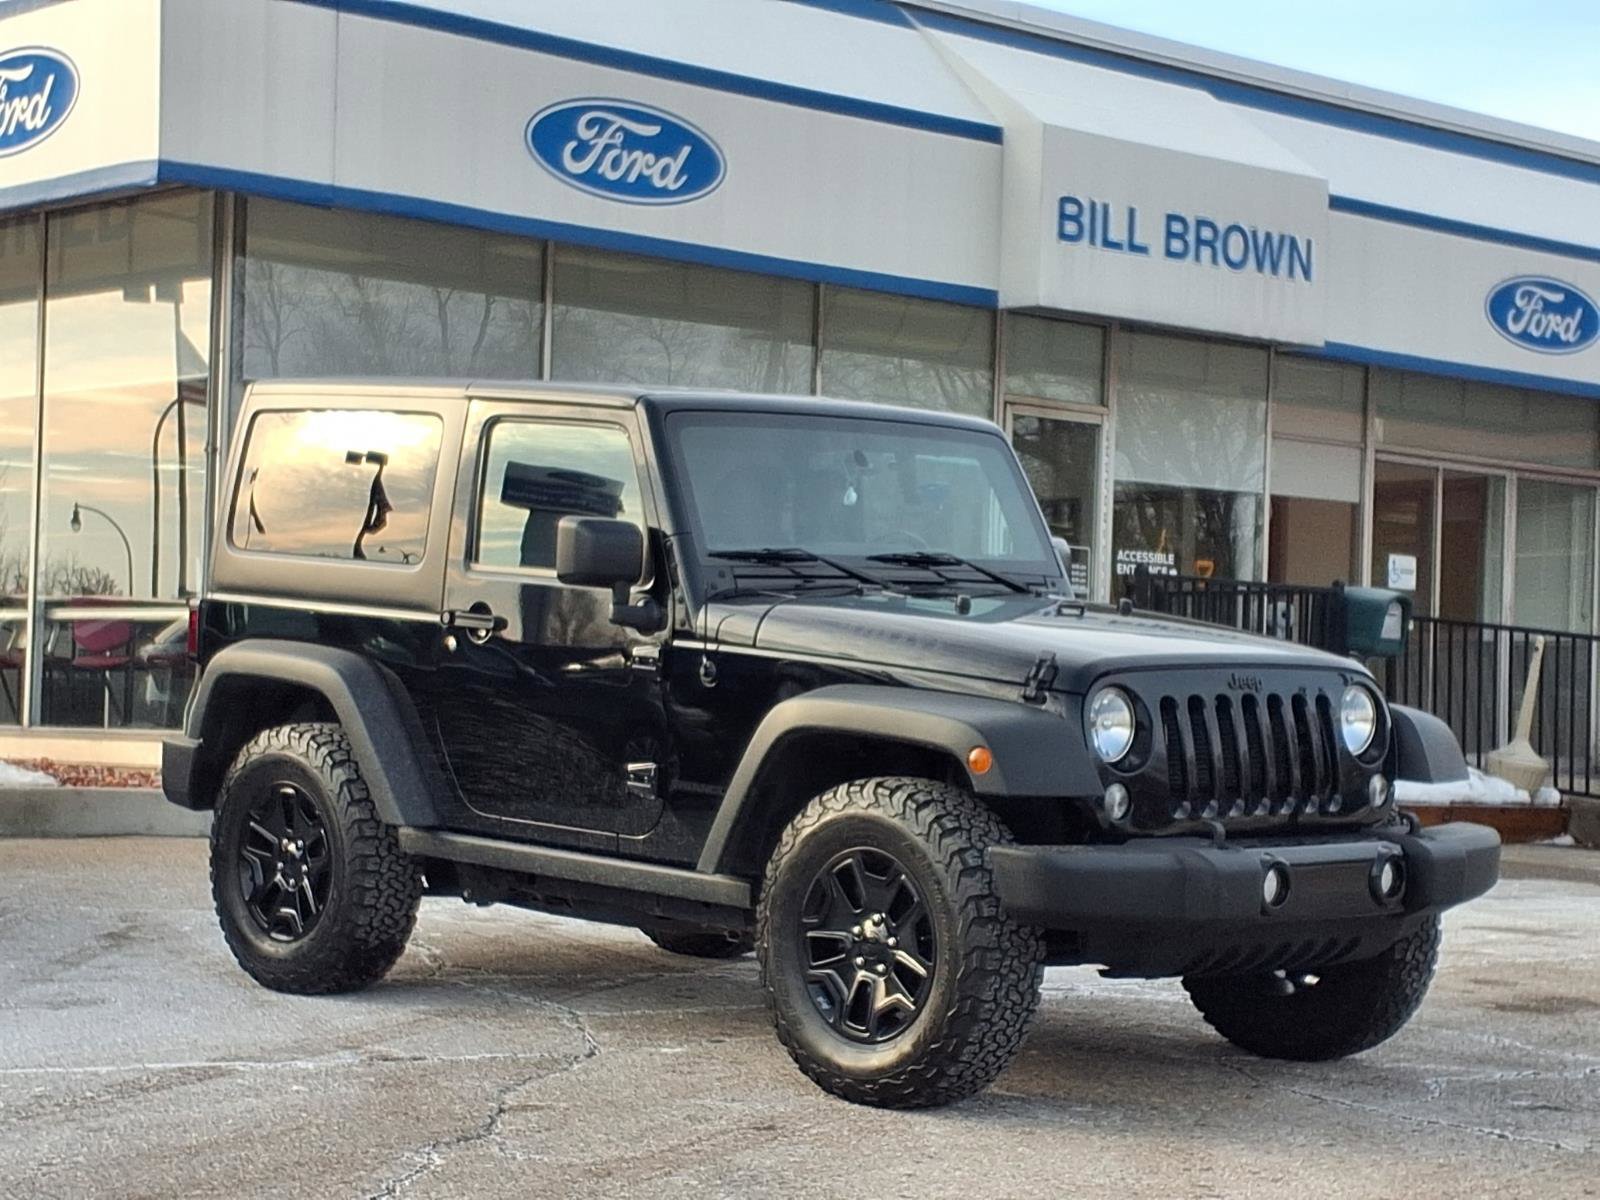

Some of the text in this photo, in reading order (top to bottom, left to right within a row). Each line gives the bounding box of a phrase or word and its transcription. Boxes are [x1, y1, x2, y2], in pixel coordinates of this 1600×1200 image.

[562, 111, 692, 190] Ford
[1057, 195, 1313, 283] BILL BROWN
[1507, 285, 1583, 342] Ford
[1116, 549, 1175, 565] ACCESSIBLE
[1116, 563, 1168, 575] ENTNCE
[1227, 672, 1263, 693] Jeep
